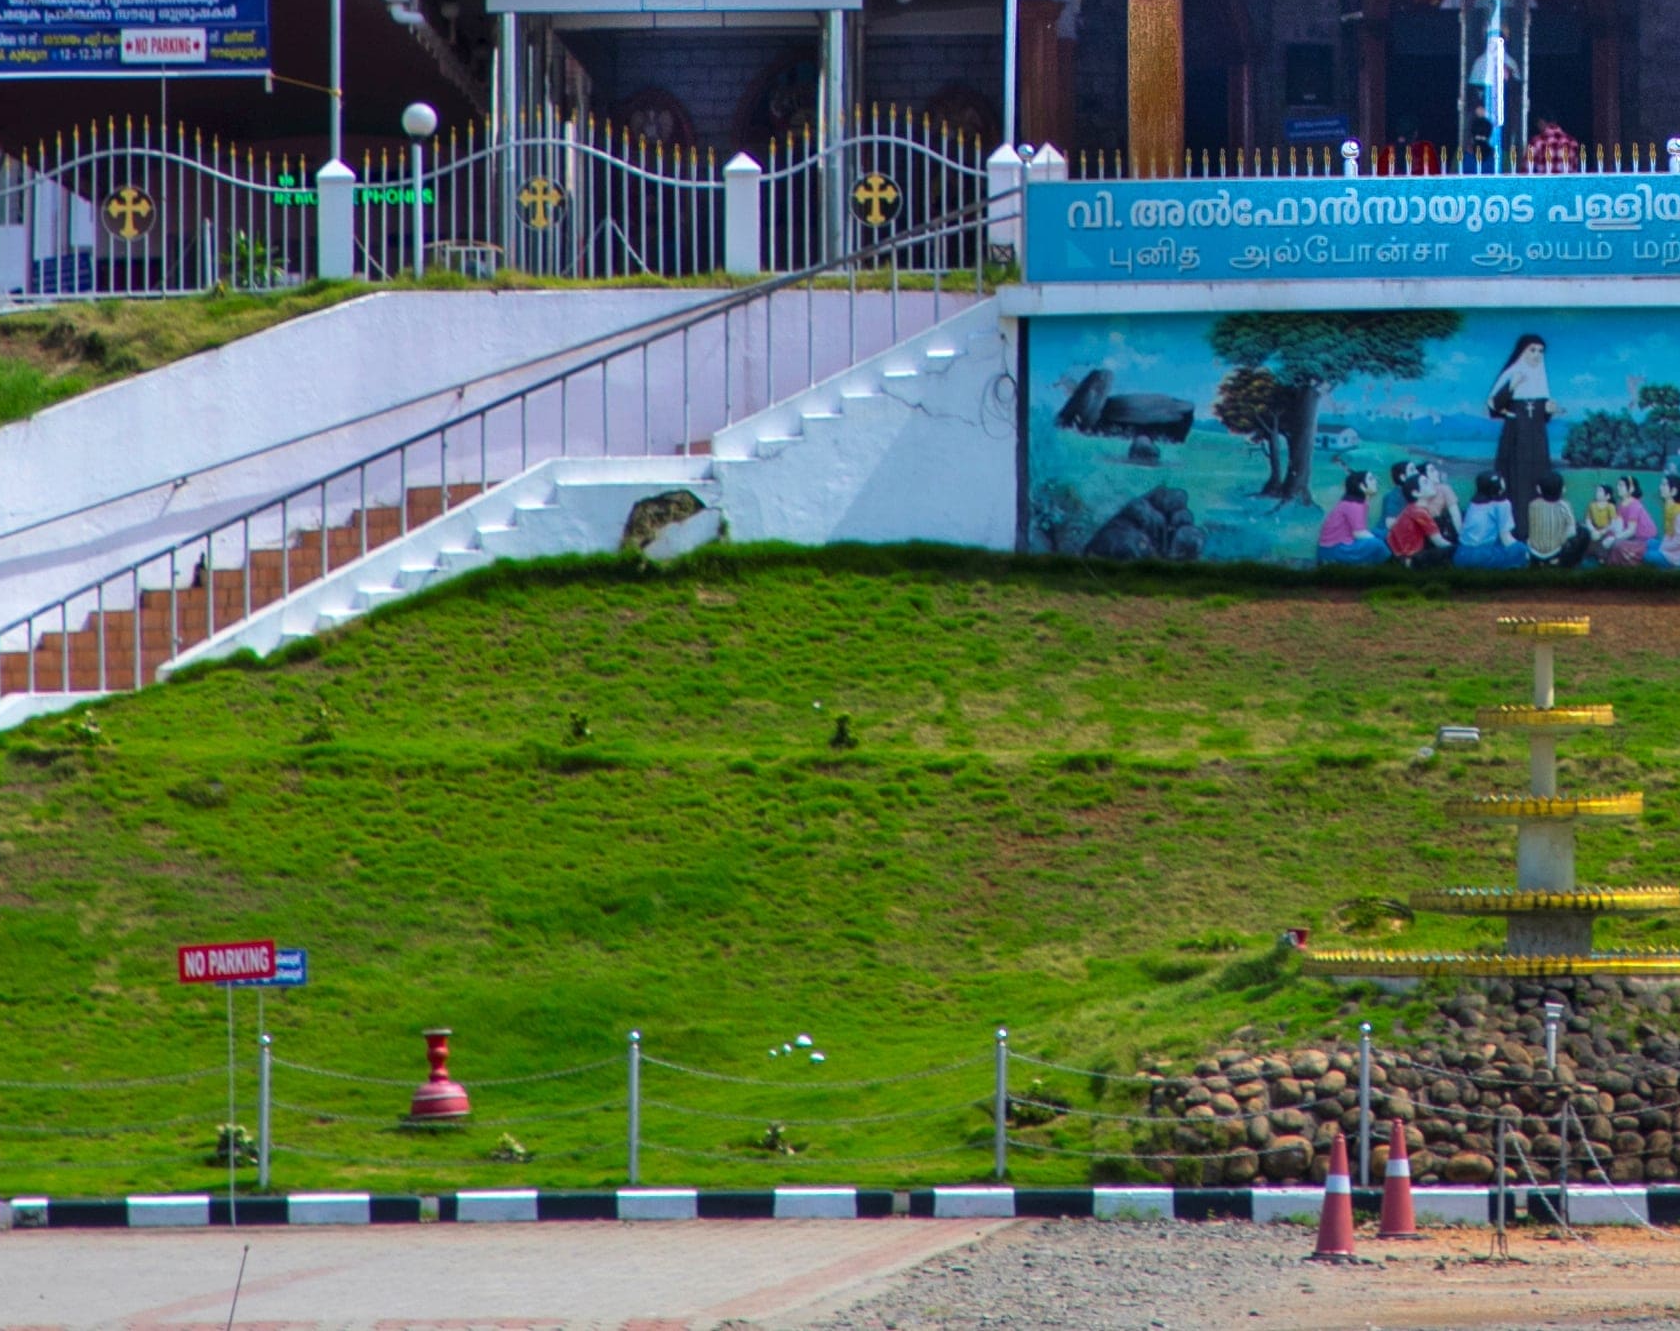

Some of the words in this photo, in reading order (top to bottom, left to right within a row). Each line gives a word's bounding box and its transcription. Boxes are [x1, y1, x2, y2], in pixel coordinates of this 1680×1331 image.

[135, 37, 148, 54] NO
[151, 36, 191, 54] PARKING
[1068, 191, 1122, 229] വി.
[1130, 188, 1535, 232] അൽഫോൻസായുടെ
[1109, 238, 1200, 274] புனித
[1229, 236, 1450, 268] அல்போன்சா
[1472, 234, 1613, 271] ஆலயம்
[184, 951, 206, 977] NO
[208, 946, 270, 975] PARKING
